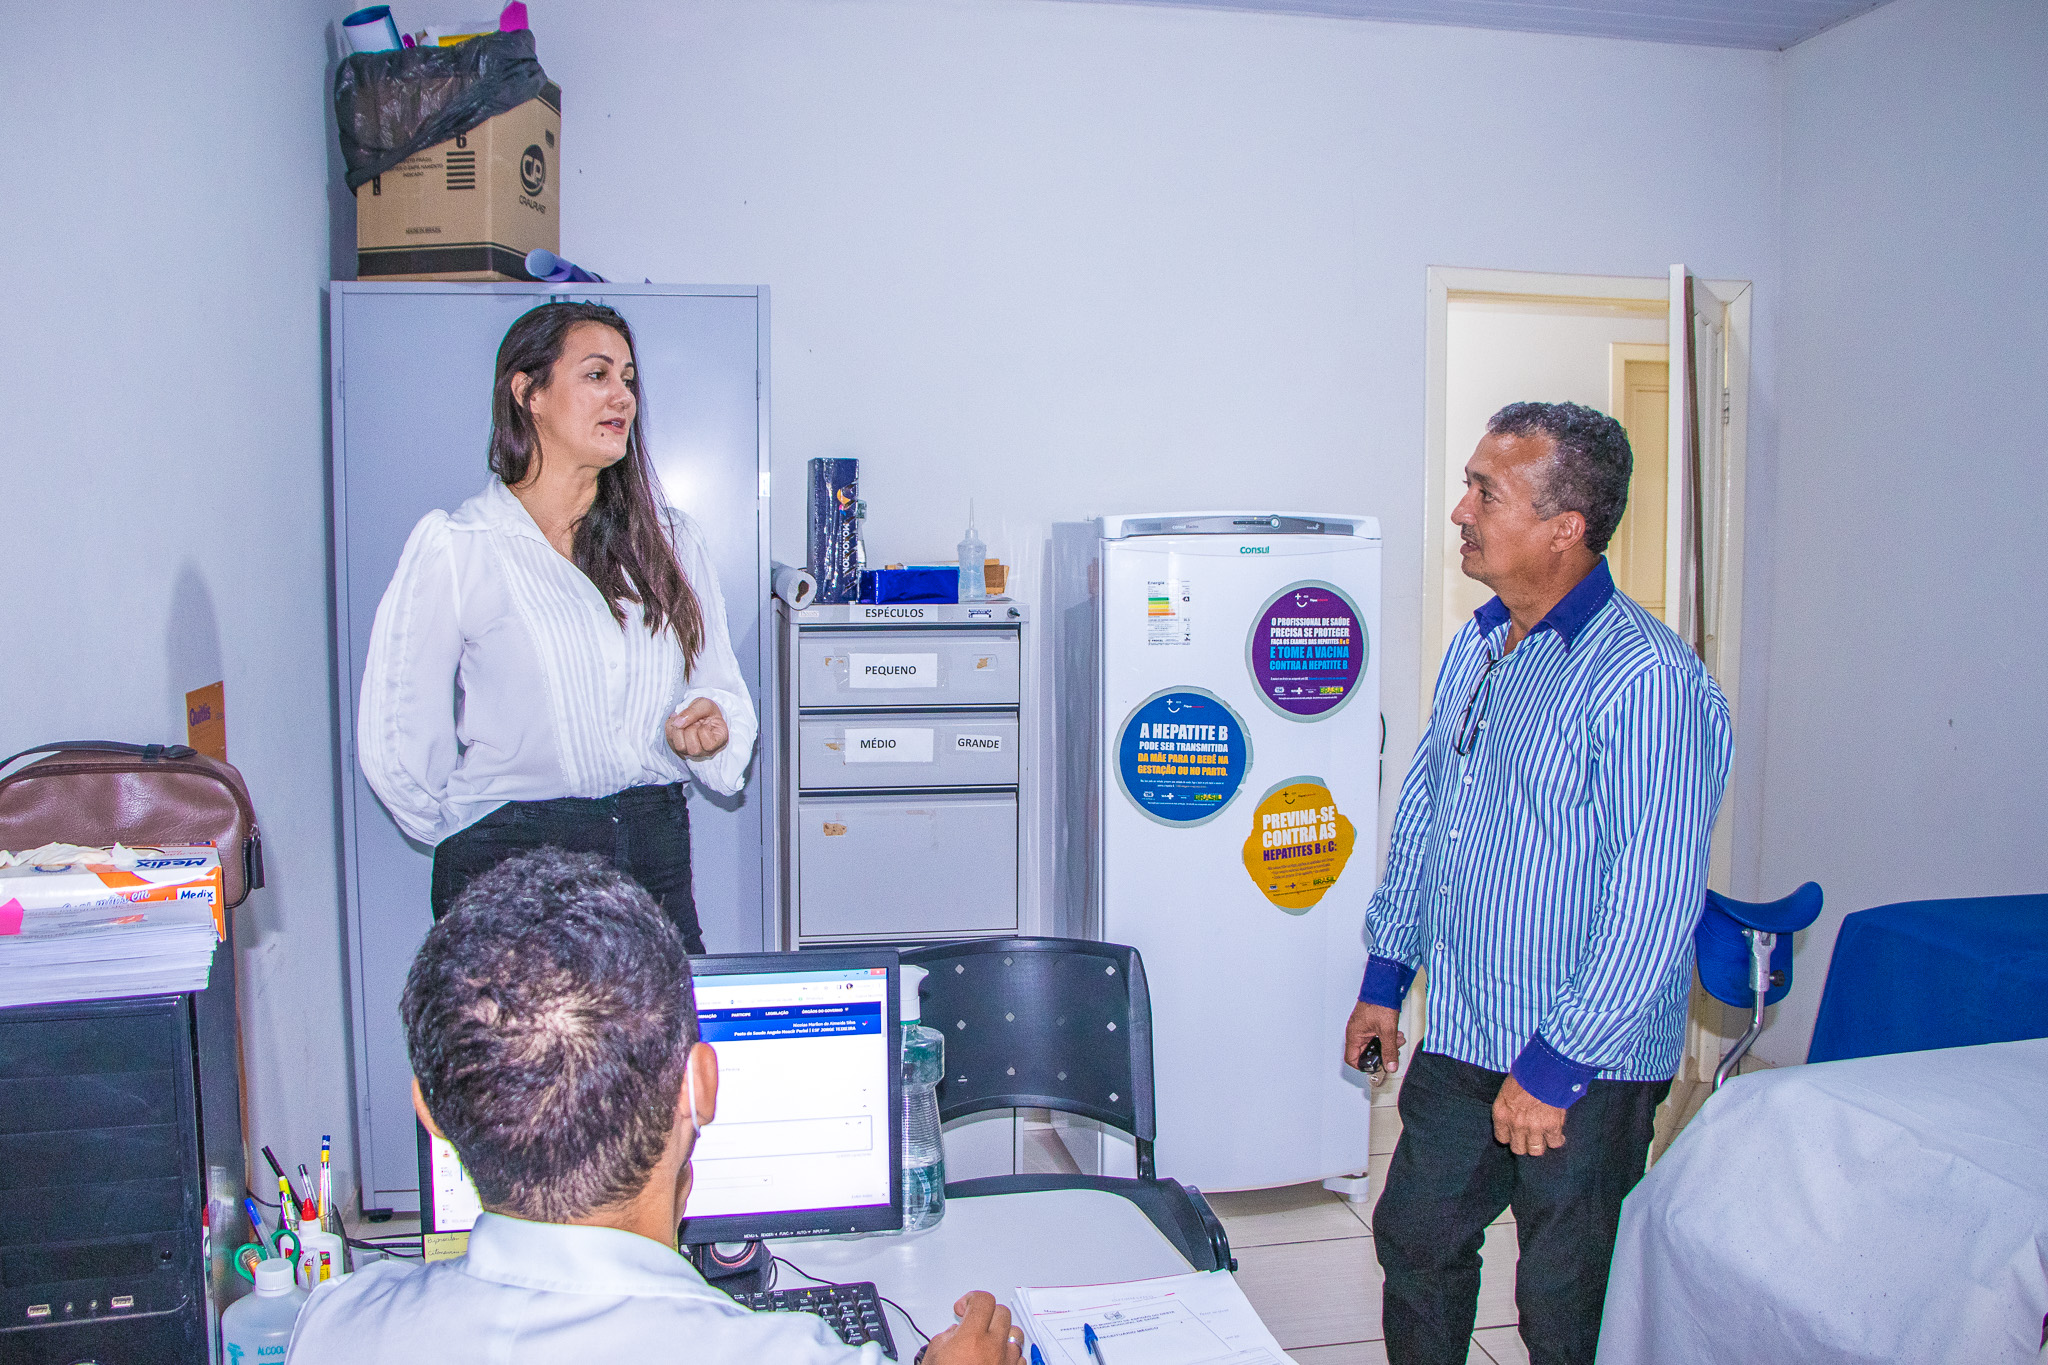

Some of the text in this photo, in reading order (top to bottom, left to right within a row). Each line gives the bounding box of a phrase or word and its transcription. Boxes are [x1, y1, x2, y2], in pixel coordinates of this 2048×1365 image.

[1239, 545, 1270, 555] Consul
[865, 606, 924, 618] ESPÉCULOS
[1271, 616, 1350, 626] O PROFISSIONAL DE SAÚDE
[1270, 627, 1350, 638] PRECISA SE PROTEGER
[1270, 646, 1350, 659] E TOME A VACINA
[865, 665, 917, 676] PEQUENO
[1270, 660, 1349, 670] CONTRA A HEPATITE B
[1139, 722, 1228, 741] A HEPATITE B
[860, 737, 1000, 749] MÉDIO GRANDE
[1139, 741, 1229, 752] PODE SER TRANSMITIDA
[1137, 752, 1149, 762] DA
[1150, 751, 1166, 762] MÃE
[1168, 754, 1188, 763] PARA
[1190, 754, 1196, 764] O
[1218, 755, 1229, 764] NA
[1137, 764, 1228, 776] GESTAÇÃO OU NO PARTO.
[1263, 806, 1335, 830] PREVINA-SE
[1263, 822, 1337, 848] CONTRA AS
[1263, 844, 1313, 861] HEPATITES
[1314, 843, 1321, 854] B
[1327, 840, 1337, 852] C:
[136, 857, 207, 868] Medix
[180, 889, 214, 900] Medix
